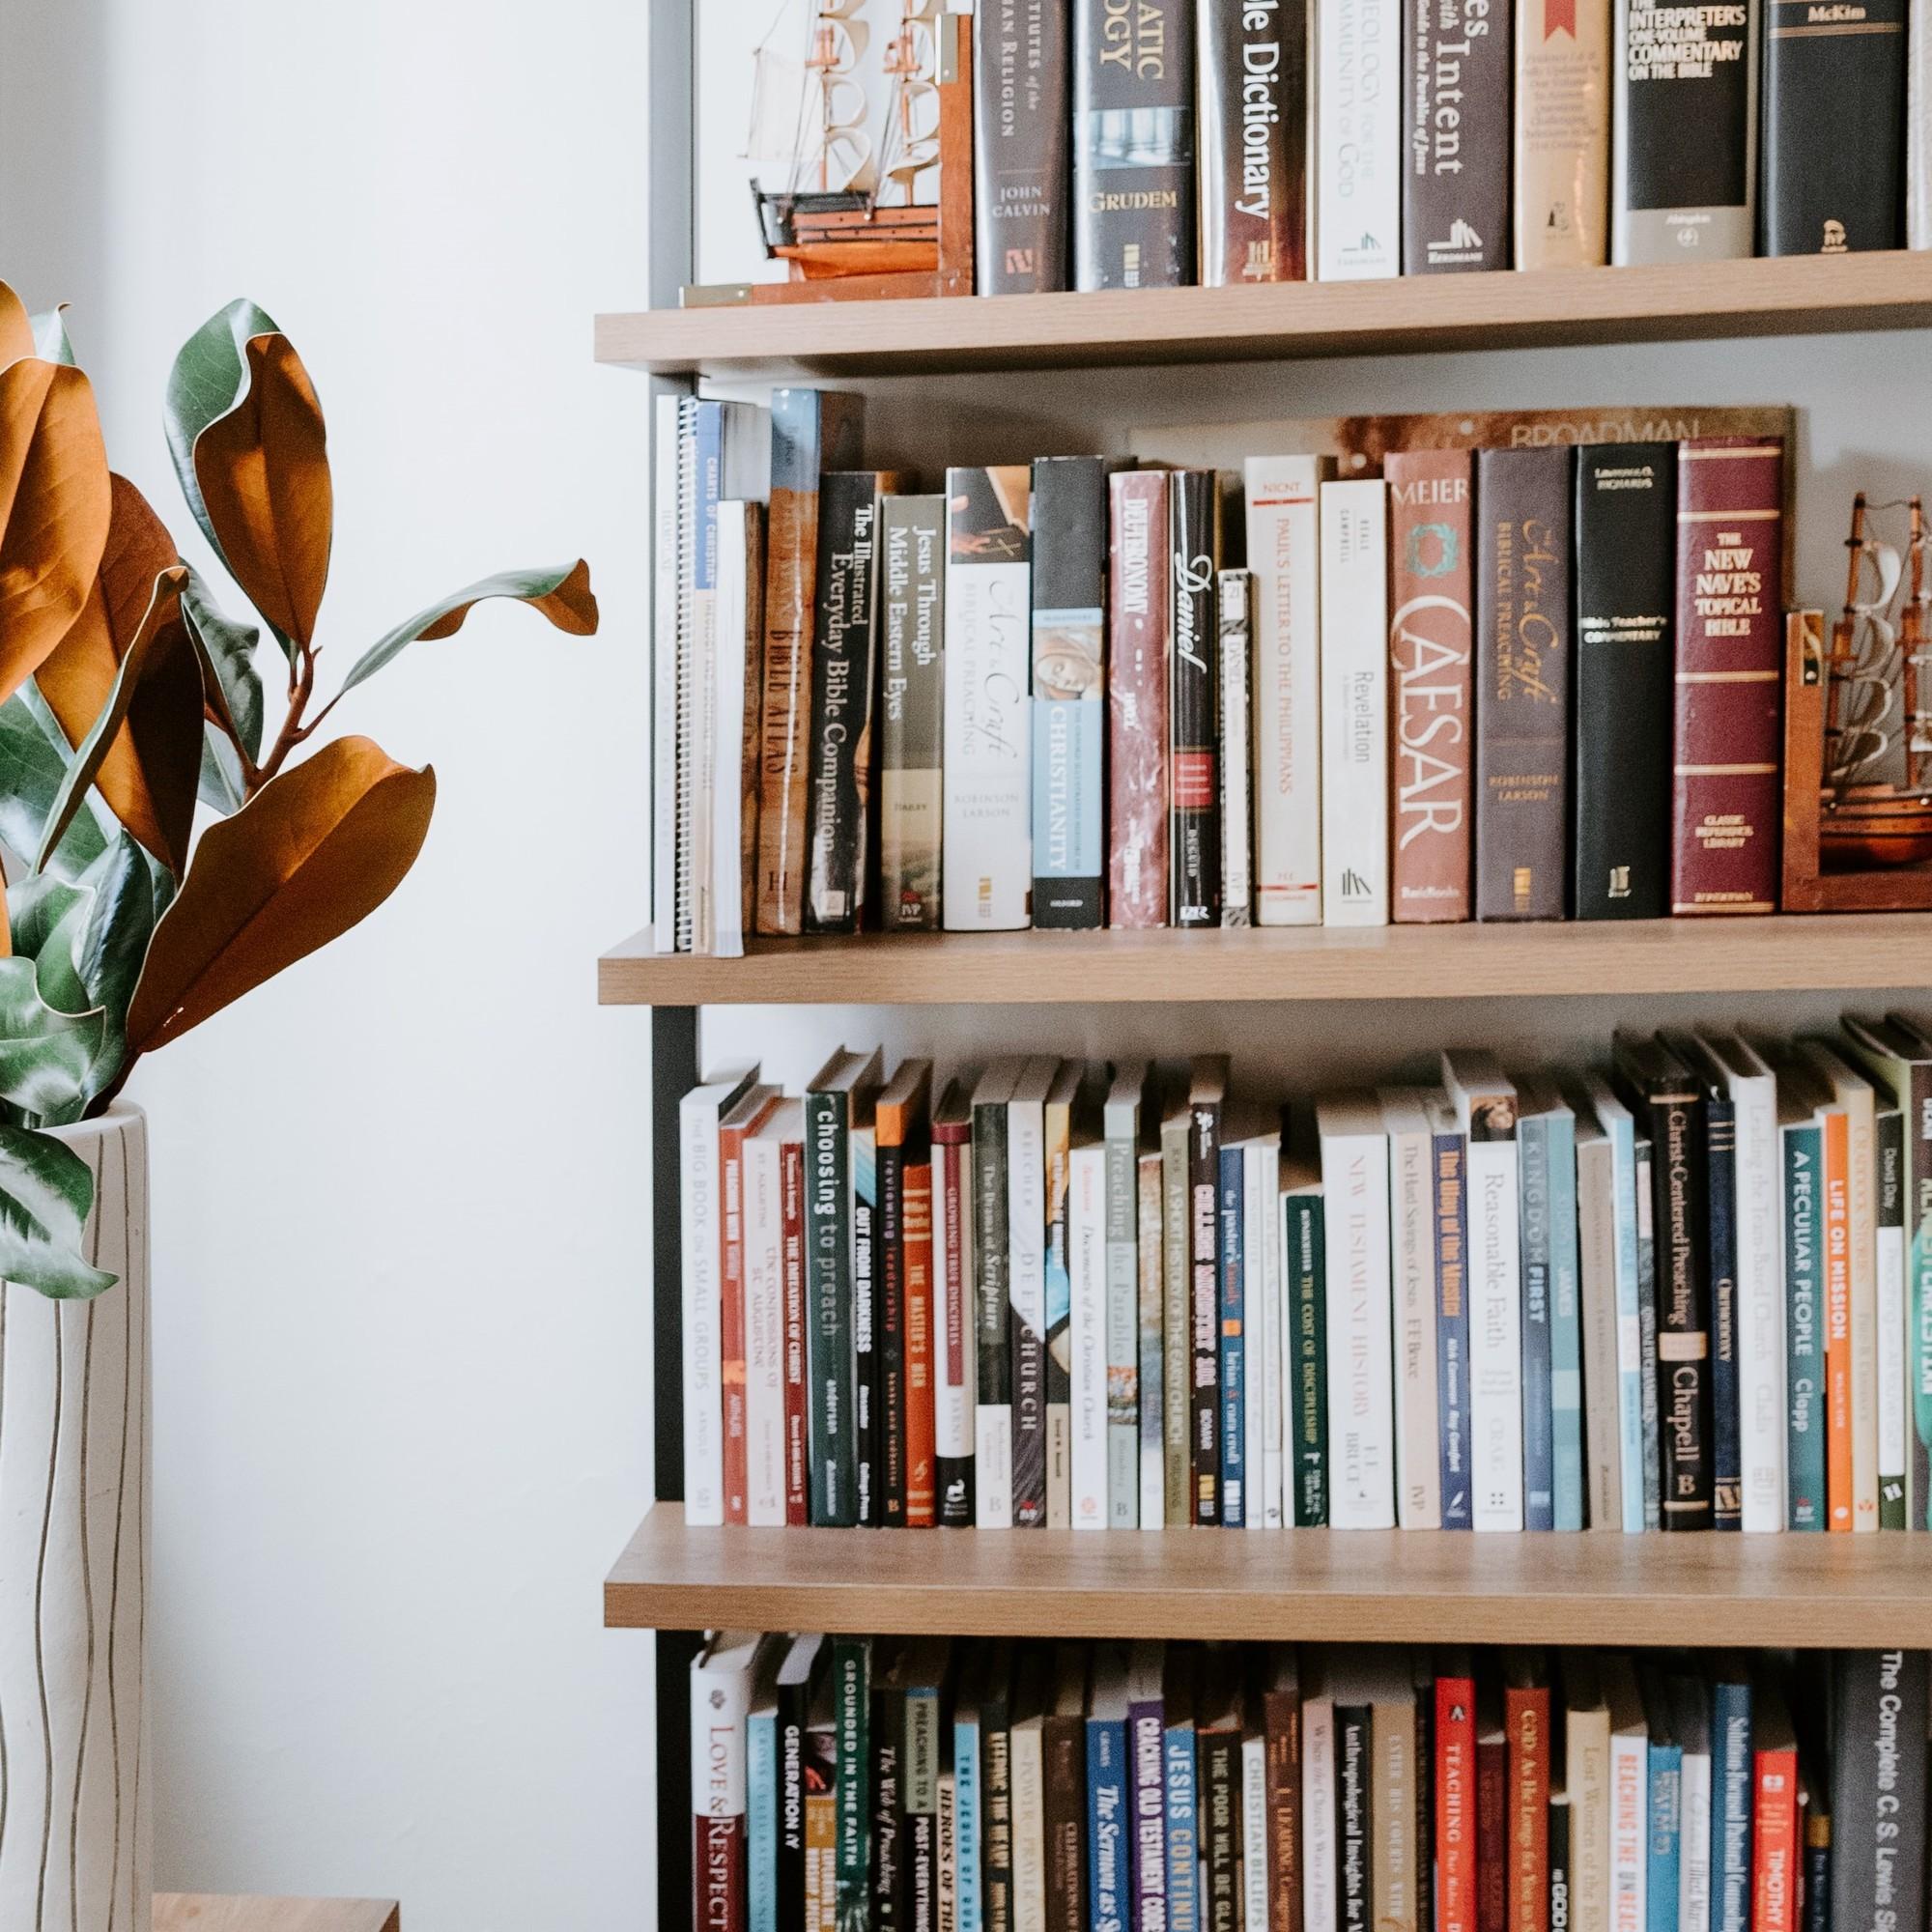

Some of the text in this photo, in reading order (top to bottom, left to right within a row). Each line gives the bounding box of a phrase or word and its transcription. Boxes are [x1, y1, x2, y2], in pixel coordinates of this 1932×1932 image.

[1628, 26, 1709, 45] ONE-VOLUME
[1628, 61, 1712, 81] ON THE BIBLE
[1629, 40, 1744, 66] COMMENTARY
[1808, 5, 1865, 21] McKim
[1235, 43, 1279, 221] Dictionary
[1435, 41, 1470, 175] Intent
[992, 204, 1050, 219] CALVIN
[1001, 186, 1041, 202] JOHN
[1088, 191, 1178, 214] GRUDEM
[1391, 478, 1469, 505] MEIER
[1511, 418, 1699, 448] BROADMAN
[850, 504, 875, 626] The Illustrated
[912, 526, 937, 665] Jesus Through
[1122, 497, 1150, 615] DEUTERONOMY
[1695, 572, 1760, 595] NAVE'S
[1704, 549, 1753, 571] NEW
[1717, 532, 1741, 546] THE
[883, 527, 908, 722] Middle Eastern Eyes
[1173, 551, 1213, 674] Daniel
[1277, 519, 1293, 794] PAUL'S LETTER TO THE PHILIPPIANS
[1496, 523, 1514, 699] BIBLICAL PREACHING
[1584, 631, 1660, 643] COMMENTARY
[1693, 596, 1762, 616] TOPICAL
[1705, 618, 1750, 637] BIBLE
[815, 553, 854, 852] Everyday Bible Companion
[1354, 671, 1374, 762] Revelation
[1391, 594, 1470, 851] CAESAR
[1050, 706, 1066, 869] CHRISTIANITY
[816, 1111, 839, 1335] choosing to preach
[884, 1160, 895, 1238] reviewing
[980, 1164, 1001, 1330] The Drama of Scripture
[1109, 1143, 1132, 1361] Preaching the Parables
[1403, 1146, 1420, 1307] The Hard Sayings of Jesus
[1485, 1174, 1506, 1289] Reasonable
[1526, 1140, 1546, 1322] KINGDOM FIRST
[1668, 1110, 1691, 1324] Christ-Centered Preaching
[1793, 1151, 1813, 1355] A PECULIAR PEOPLE
[693, 1145, 710, 1390] BIG BOOK SMALL GROUPS
[856, 1208, 871, 1352] OUT FROM DARKNESS
[910, 1265, 925, 1352] THE MASTER'S
[947, 1186, 962, 1348] GROWING TRUE DISCIPLES
[1350, 1155, 1368, 1416] NEW TESTAMENT HISTORY
[1830, 1180, 1846, 1339] LIFE ON MISSION
[789, 1342, 801, 1384] CHRIST
[1021, 1253, 1037, 1429] DEEP CHURCH
[1082, 1226, 1095, 1440] Documents Christian Church
[1169, 1198, 1183, 1444] SHORT HISTORY OF THE EARLY CHURCH
[1302, 1304, 1317, 1443] COST OF DISCIPLESHIP
[1487, 1297, 1507, 1348] Faith
[1347, 1433, 1359, 1482] BRUCE
[1667, 1367, 1699, 1461] Chapell
[1791, 1378, 1813, 1433] Clapp
[785, 1725, 799, 1829] GENERATION
[844, 1661, 858, 1865] GROUNDED IN THE FAITH
[915, 1702, 928, 1796] PREACHING TO
[1097, 1785, 1119, 1820] The
[1137, 1718, 1164, 1894] CRACKING OLD TESTAMENT
[1169, 1746, 1192, 1819] JESUS
[1445, 1745, 1462, 1842] TEACHING
[1583, 1746, 1603, 1847] Lost Women
[1618, 1754, 1637, 1862] REACHING THE
[1724, 1717, 1749, 1874] Solution-Focused Pastoral
[1874, 1651, 1902, 1905] The Complete C. S. Lewis
[708, 1725, 735, 1930] LOVE & RESPECT
[877, 1747, 896, 1893] The Web of Preaching
[916, 1817, 929, 1932] POST-EVERYTHING
[941, 1789, 953, 1932] HEROES OF THE
[1097, 1822, 1119, 1890] Sermon
[1212, 1747, 1230, 1894] THE POOR WILL BE
[1248, 1756, 1267, 1926] CHRISTIAN BELIEFS
[1343, 1726, 1363, 1919] Anthropological Insights for
[1099, 1892, 1116, 1915] as
[1390, 1882, 1406, 1917] WITH
[1767, 1849, 1785, 1925] TIMOTHY
